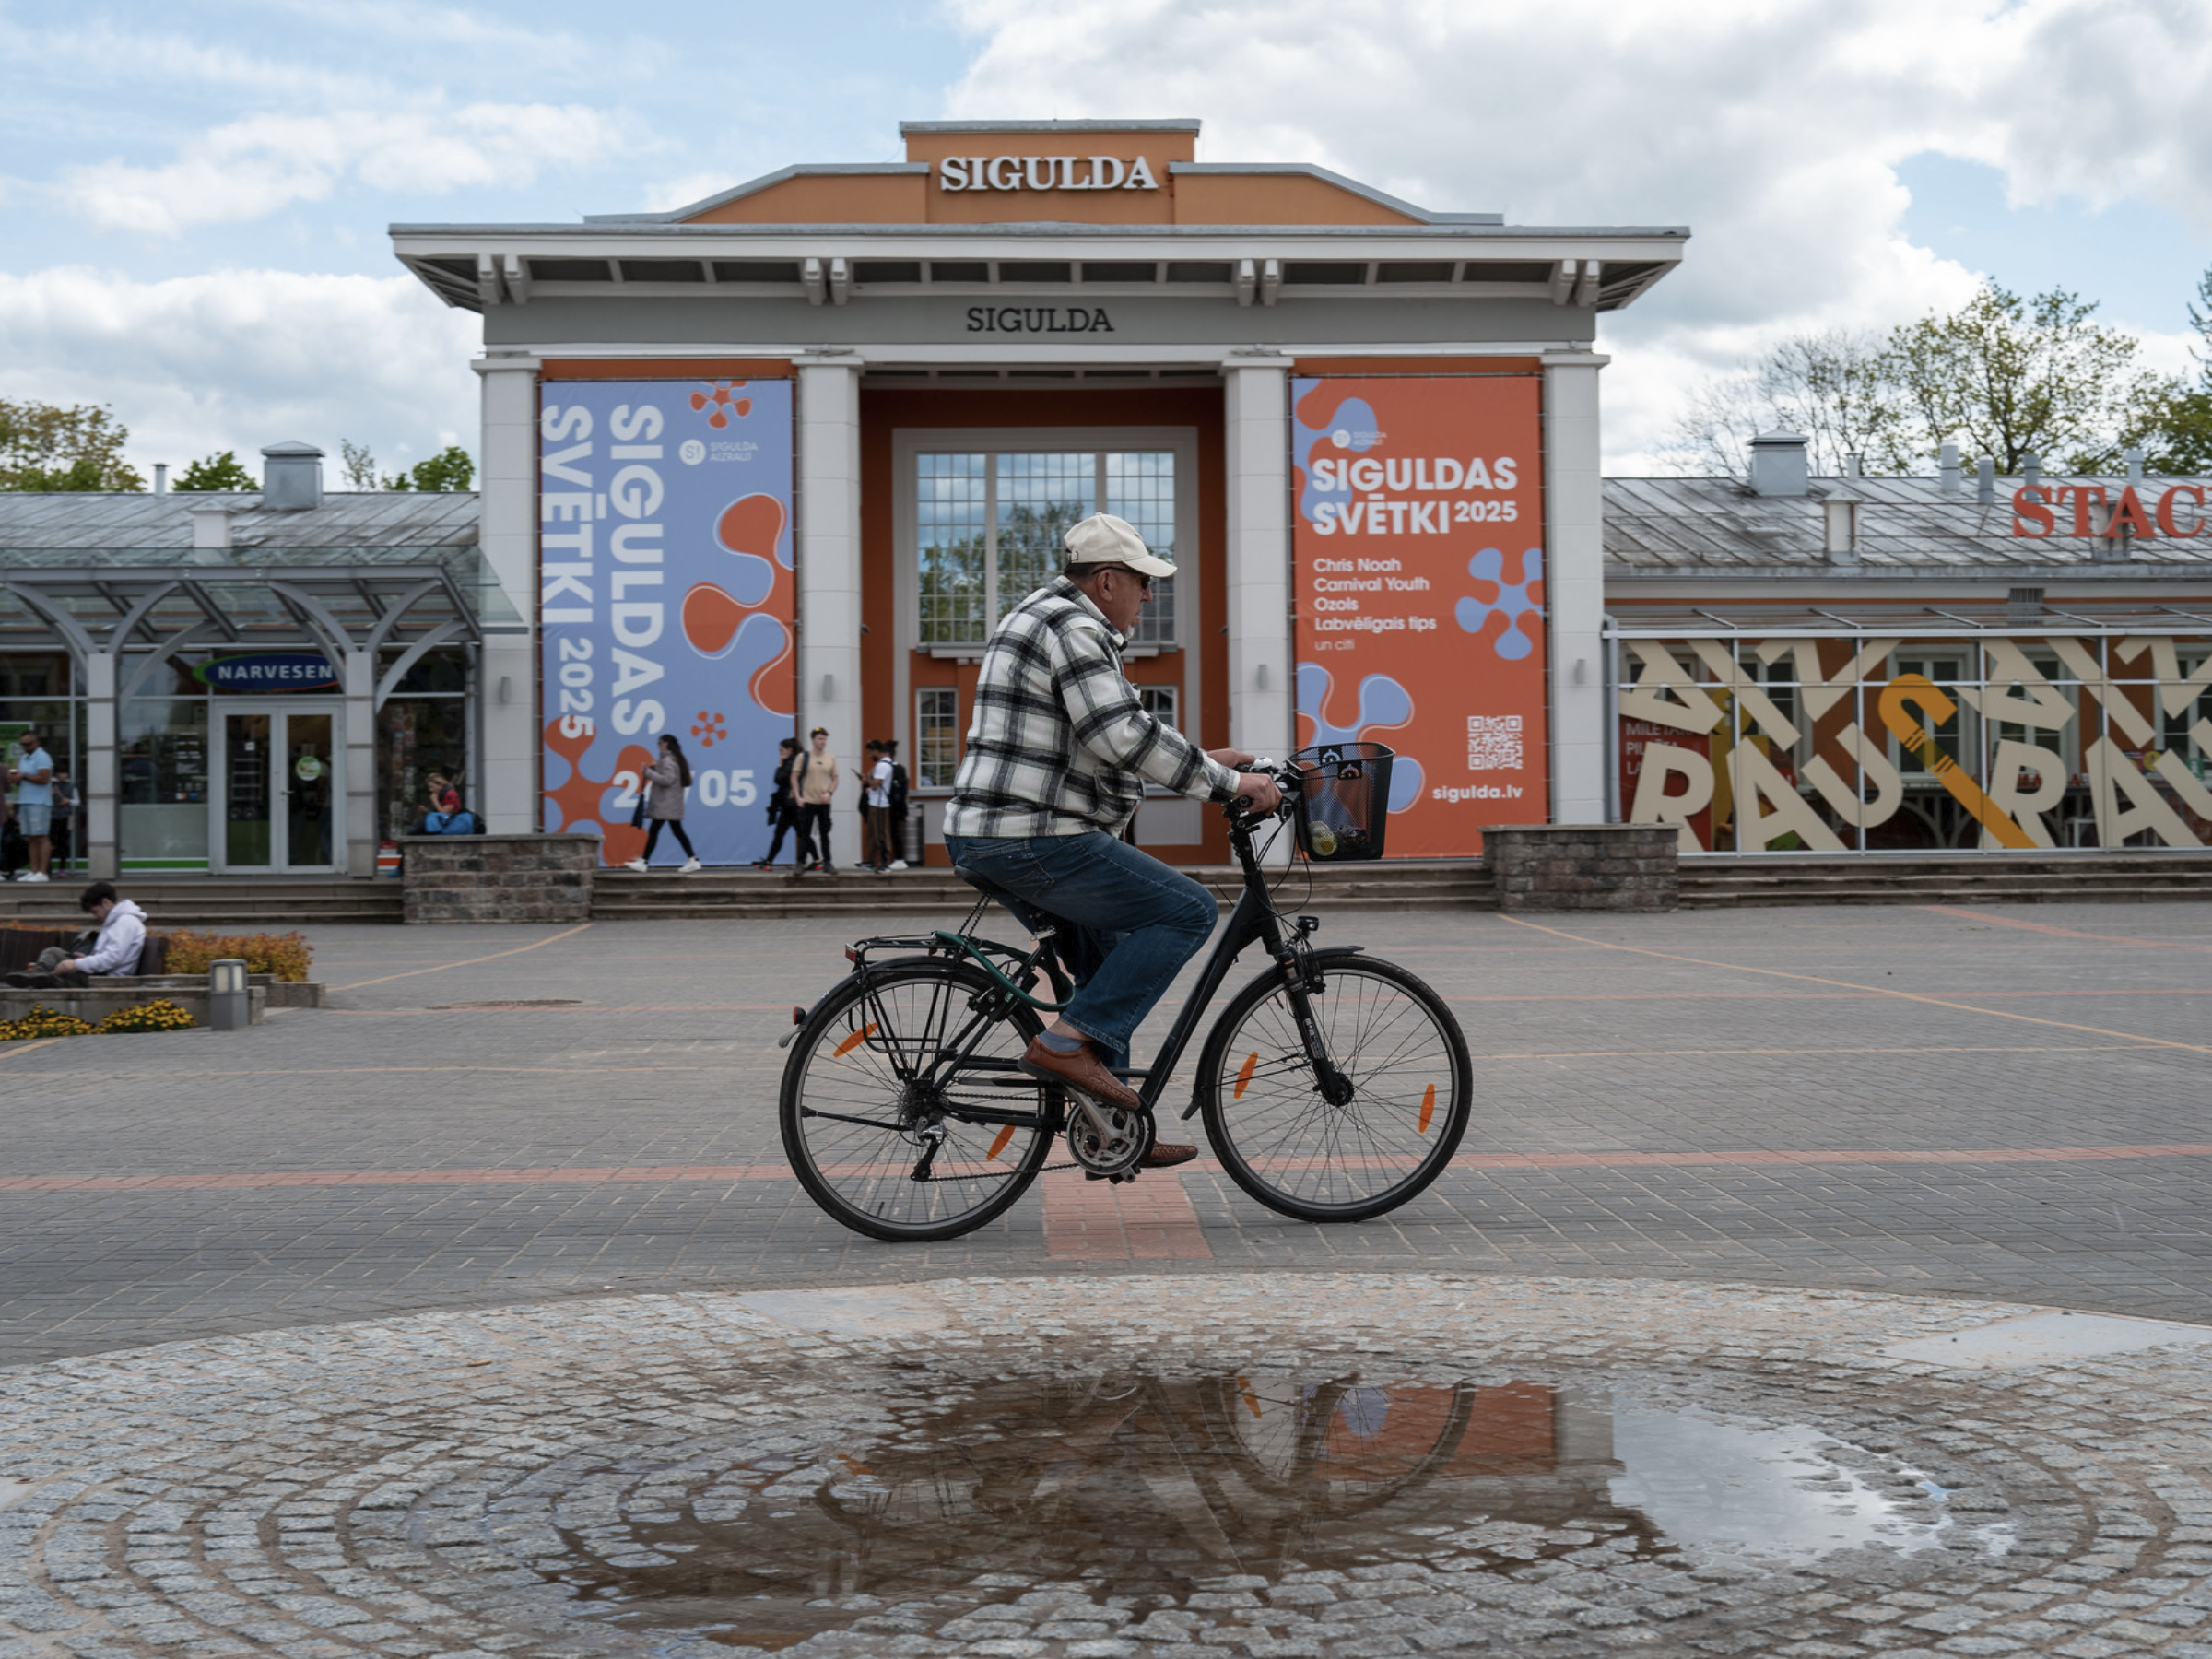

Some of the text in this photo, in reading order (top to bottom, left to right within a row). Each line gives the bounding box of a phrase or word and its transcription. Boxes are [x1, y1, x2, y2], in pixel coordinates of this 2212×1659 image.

[940, 156, 1159, 190] SIGULDA
[967, 307, 1114, 333] SIGULDA
[1312, 456, 1518, 492] SIGULDAS
[1312, 493, 1518, 535] SVĒTKI 2025
[2013, 485, 2212, 538] STAC
[541, 406, 606, 739] SVĒTKI 2025
[609, 405, 665, 735] SIGULDAS
[1313, 558, 1402, 572] Chris Noah
[1313, 576, 1430, 592] Carnival Youth
[1313, 596, 1359, 611] Ozols
[1314, 616, 1437, 633] Labvēlīgais tips
[1314, 641, 1333, 651] un
[218, 665, 333, 680] NARVESEN
[1432, 785, 1524, 804] sigulda.lv
